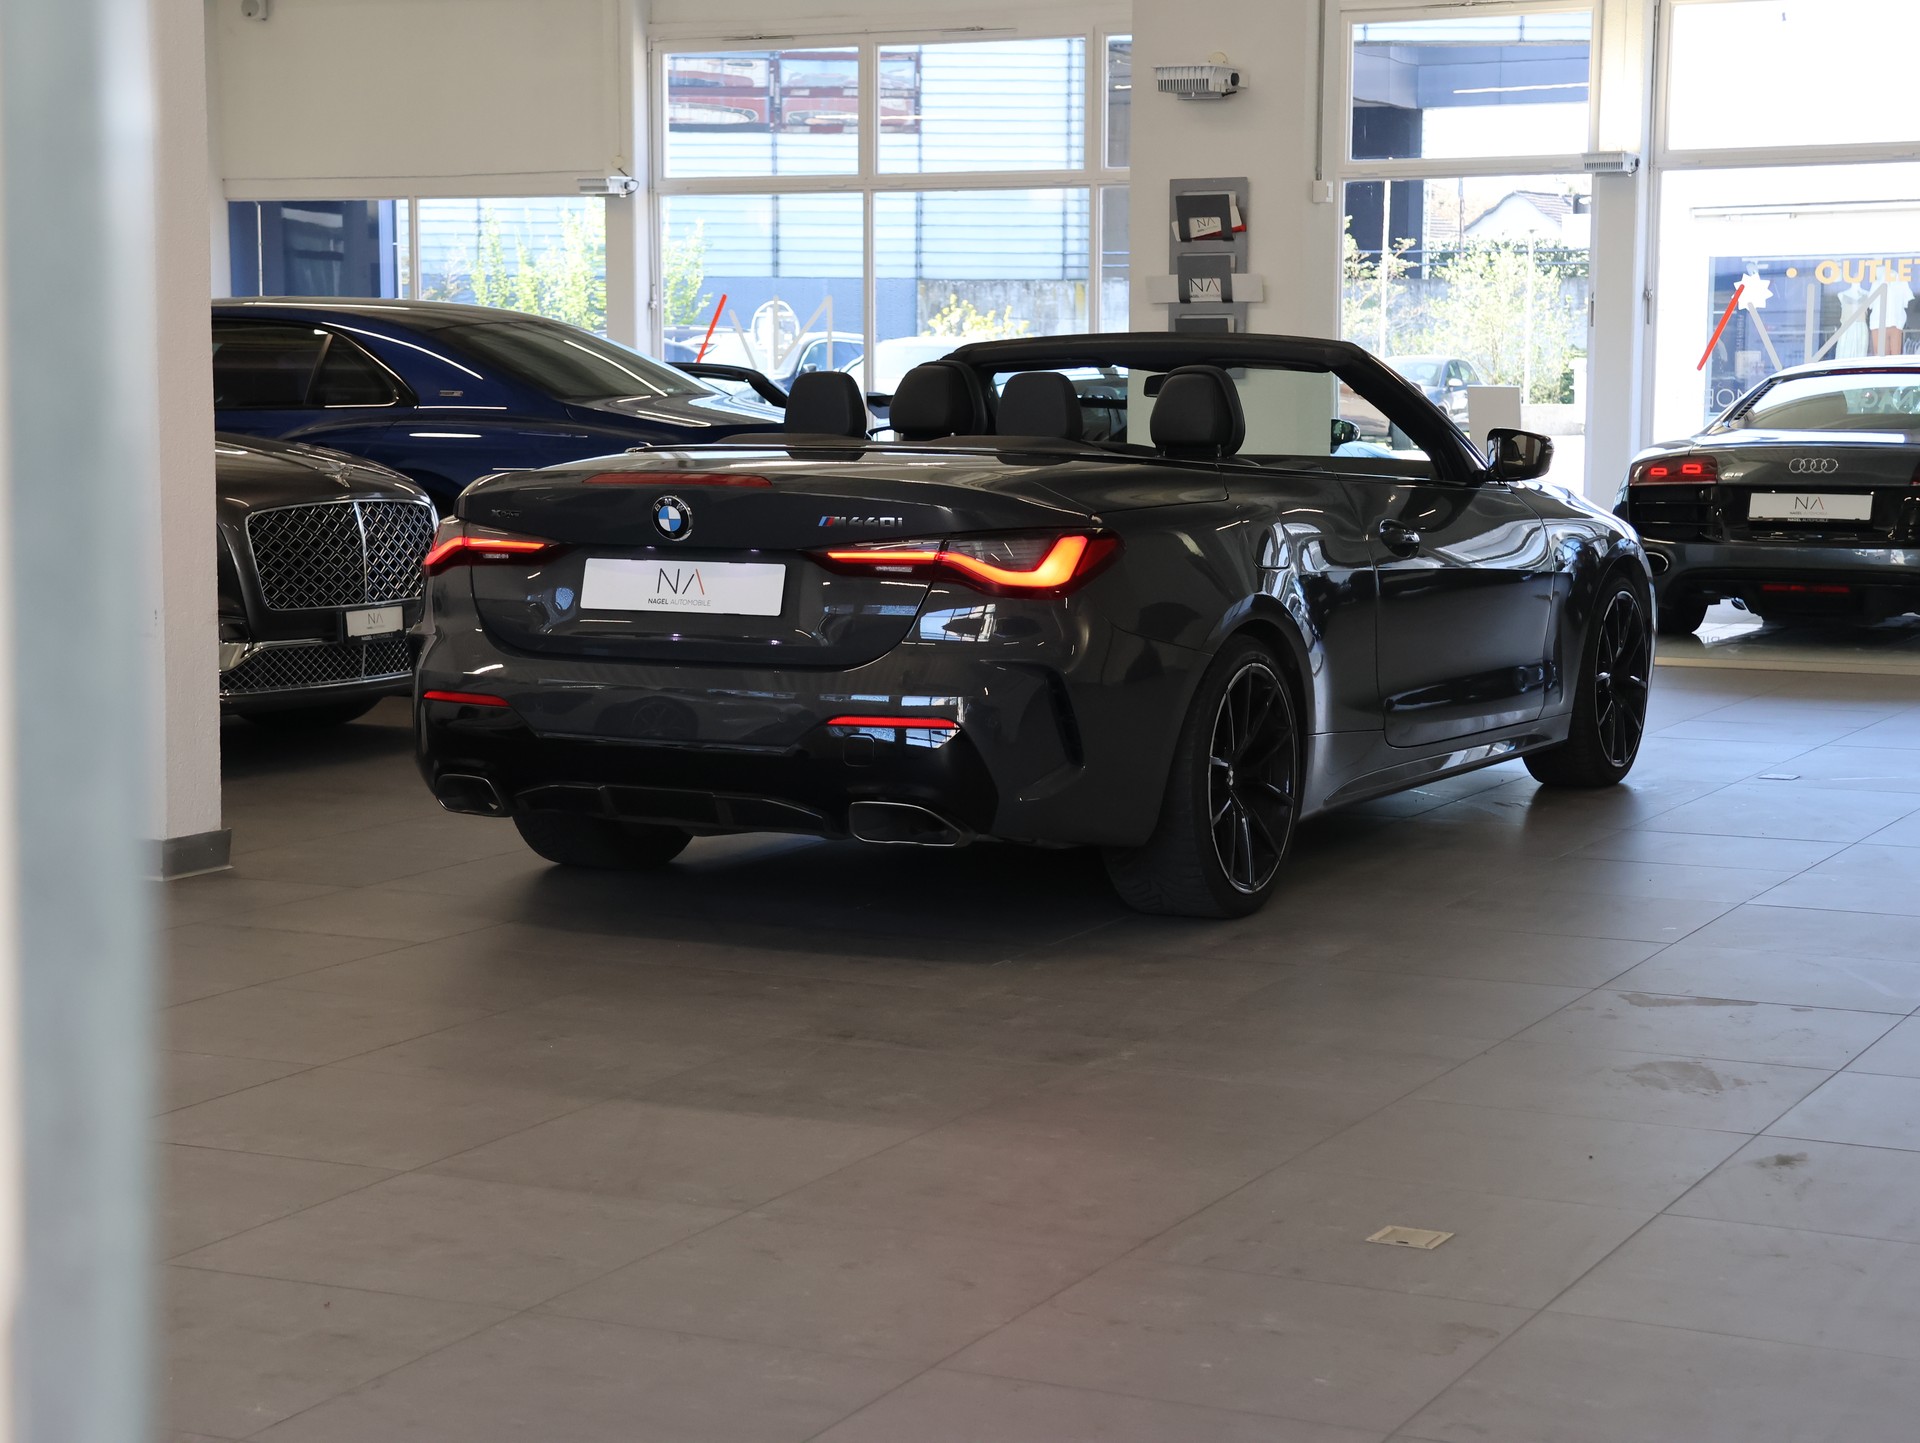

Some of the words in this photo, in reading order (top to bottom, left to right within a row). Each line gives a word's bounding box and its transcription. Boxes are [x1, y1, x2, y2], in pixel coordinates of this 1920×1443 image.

[1795, 496, 1824, 510] NA
[657, 568, 705, 595] NA
[670, 599, 712, 607] AUTOMOBILE
